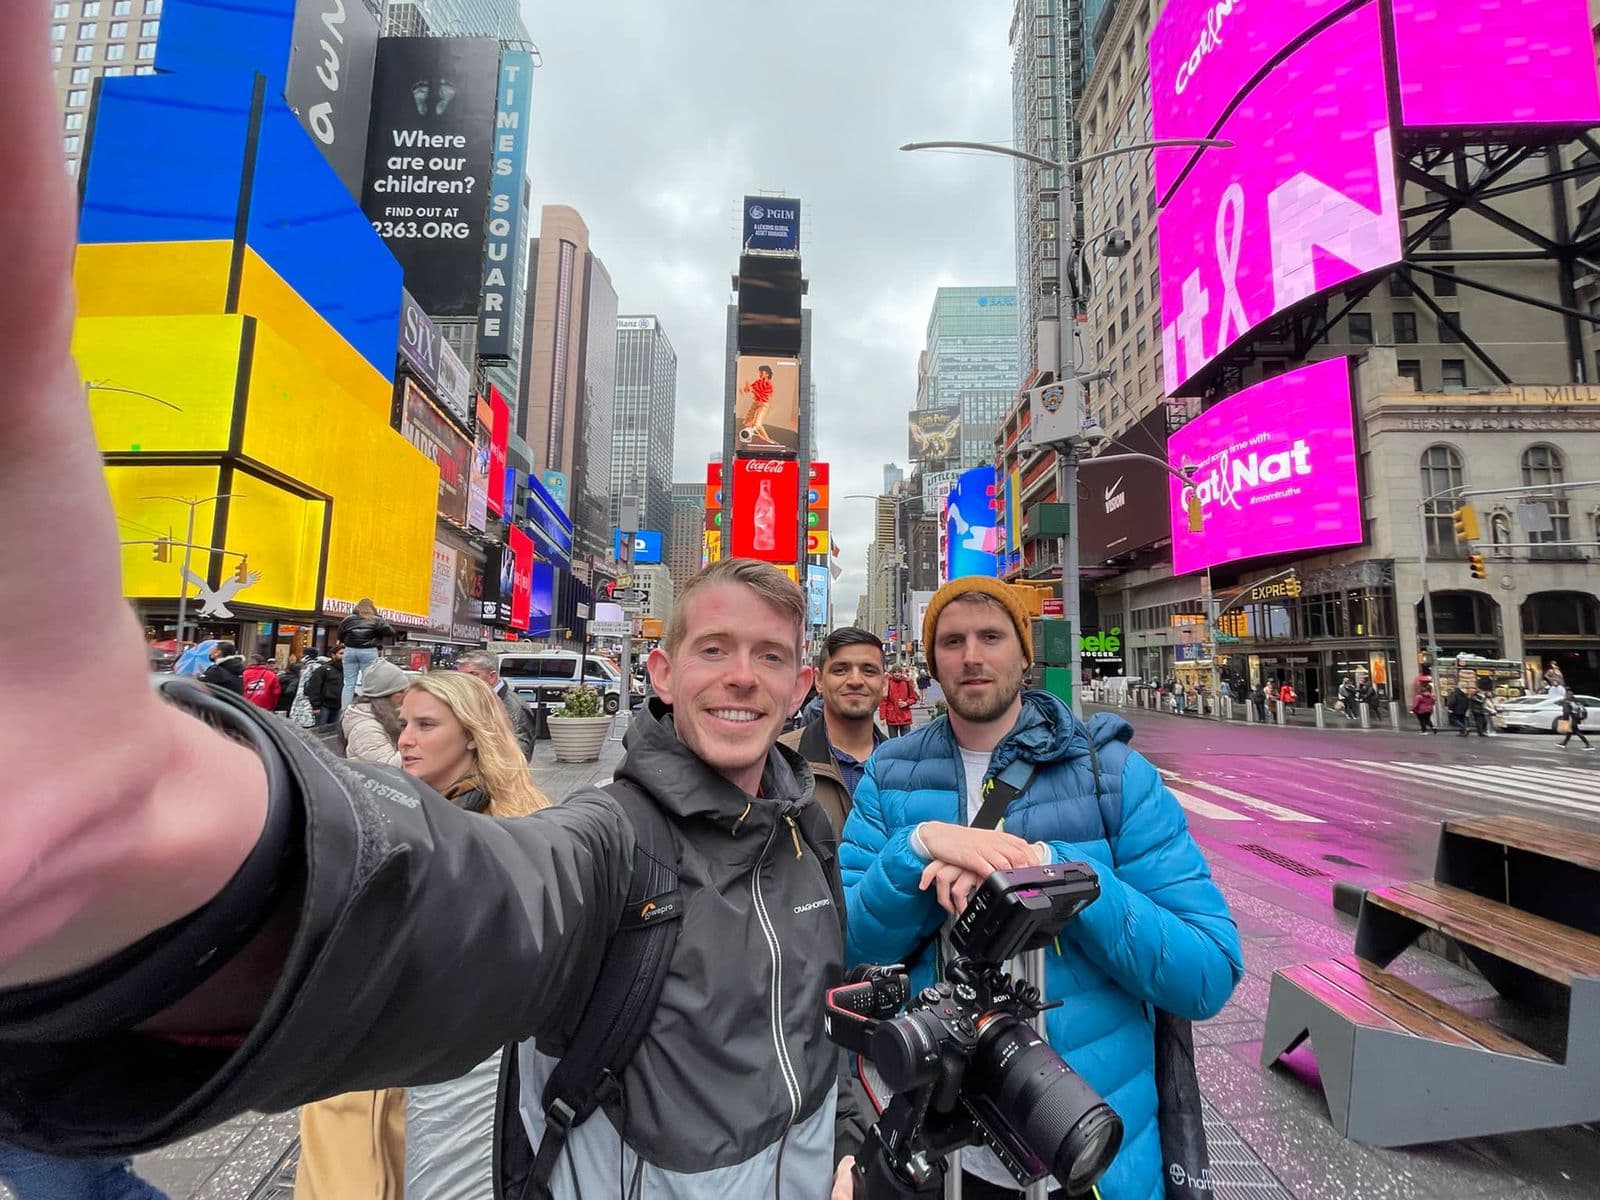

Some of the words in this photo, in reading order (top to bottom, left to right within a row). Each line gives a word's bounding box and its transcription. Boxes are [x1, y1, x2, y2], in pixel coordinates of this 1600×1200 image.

[496, 65, 520, 176] TIMES
[392, 130, 466, 148] Where
[387, 157, 425, 171] are
[429, 157, 466, 171] our
[374, 175, 475, 194] children?
[385, 207, 414, 217] FIND
[417, 207, 441, 217] OUT
[444, 207, 459, 217] AT
[767, 208, 794, 220] PGIM
[484, 194, 510, 337] SQUARE
[1248, 432, 1271, 445] with
[1252, 580, 1302, 600] EXPRES
[363, 779, 421, 808] SYSTEMS
